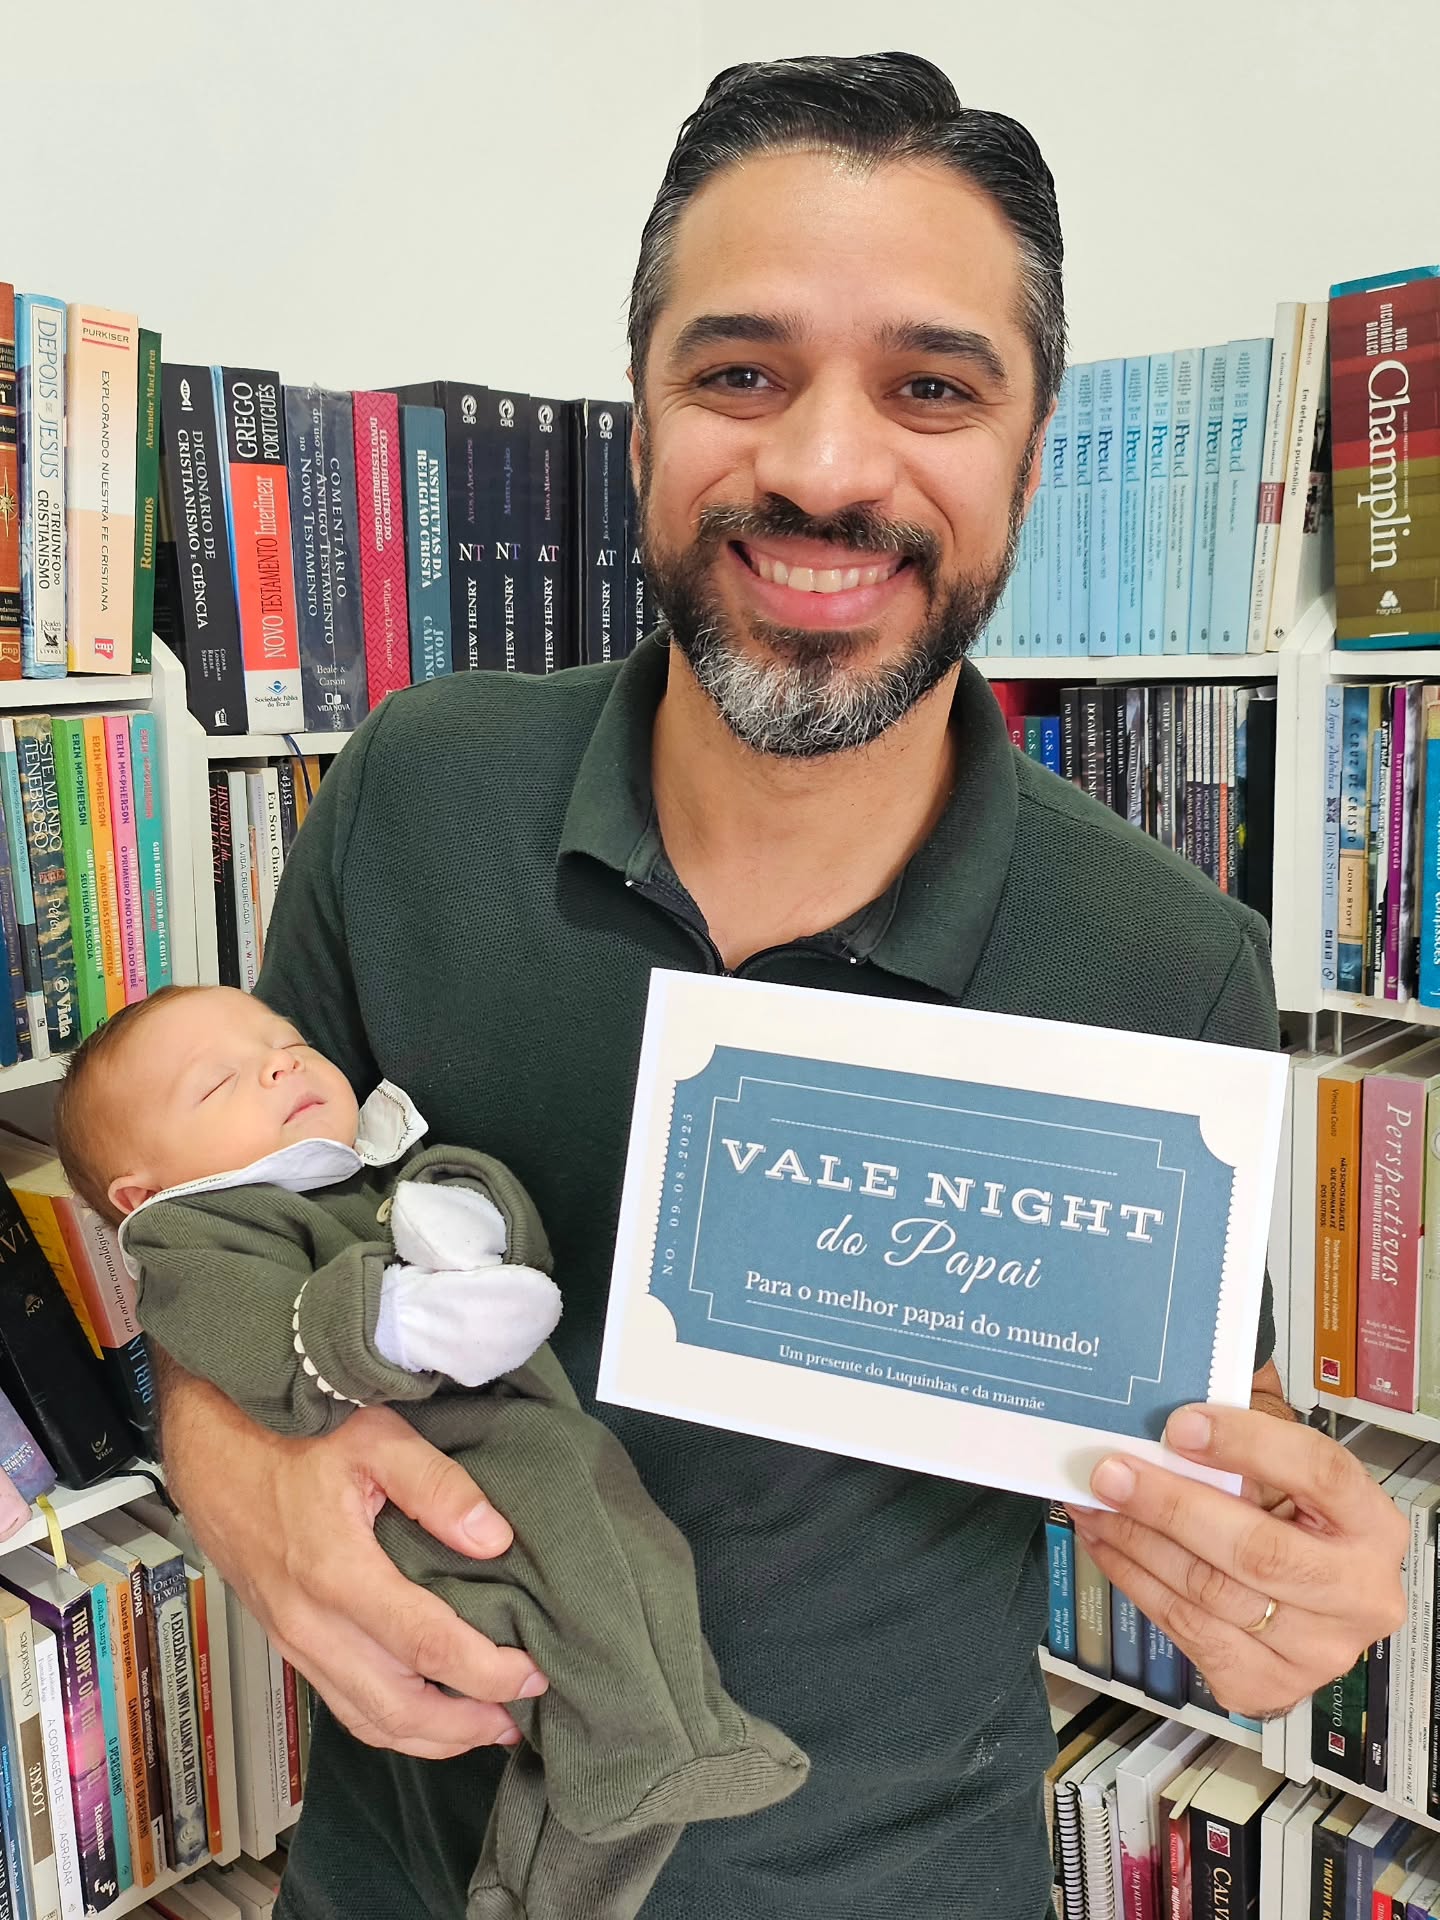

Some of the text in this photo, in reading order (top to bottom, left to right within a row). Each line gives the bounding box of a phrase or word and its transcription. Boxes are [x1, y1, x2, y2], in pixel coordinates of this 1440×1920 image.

[83, 327, 130, 344] PURKISER
[1366, 322, 1378, 356] BÍBLICO
[1380, 303, 1392, 353] DICIONÁRIO
[1395, 327, 1407, 351] NOVO
[37, 318, 60, 478] DEPOIS JESUS
[232, 382, 254, 459] GREGO
[255, 384, 280, 460] PORTUGUÊS
[145, 402, 155, 449] Alexander
[1151, 425, 1168, 479] Freud
[1174, 424, 1190, 478] Freud
[1205, 420, 1222, 476] Freud
[1230, 417, 1247, 473] Freud
[1053, 436, 1068, 488] Freud
[1076, 434, 1091, 486] Freud
[1098, 429, 1113, 483] Freud
[1126, 429, 1141, 483] Freud
[1357, 359, 1412, 573] Champlin
[100, 370, 109, 612] EXPLORANDO NUESTRA FE CRISTIANA
[193, 430, 216, 560] DICIONÁRIO DE
[316, 472, 327, 536] ANTIGO
[37, 490, 50, 589] CRISTIANISMO
[51, 510, 61, 570] TRIUNFO
[140, 497, 154, 569] Romanos
[177, 430, 209, 629] CRISTIANISMO CIÊNCIA
[301, 457, 318, 617] NOVO TESTAMENTO
[330, 457, 346, 598] COMENTÁRIO
[375, 518, 383, 551] GREGO
[429, 459, 442, 580] INSTITUTAS DA
[255, 476, 286, 659] NOVO TESTAMENTO Interlinear
[459, 542, 484, 562] NT
[496, 542, 521, 560] NT
[538, 545, 560, 562] AT
[596, 549, 617, 567] AT
[319, 537, 334, 644] TESTAMENTO
[383, 578, 394, 618] William
[468, 576, 477, 628] HENRY
[505, 575, 515, 624] HENRY
[544, 576, 553, 625] HENRY
[602, 580, 611, 629] HENRY
[636, 579, 644, 626] HENRY
[317, 665, 337, 674] Beale
[319, 677, 346, 686] Carson
[72, 733, 80, 759] ERIN
[92, 735, 100, 760] ERIN
[116, 733, 124, 761] ERIN
[1325, 712, 1337, 789] Igreja Autêntica
[24, 740, 41, 851] TENEBROSO
[43, 766, 63, 851] MUNDO
[1347, 732, 1359, 843] CRUZ DE CRISTO
[1392, 753, 1404, 869] hermenêutica avançada
[267, 791, 277, 840] Eu Sou
[1202, 832, 1210, 864] ORAÇÃO
[1227, 844, 1235, 877] ORAÇÃO
[1325, 830, 1336, 897] JOHN STOTT
[121, 855, 130, 897] PRIMEIRO
[1345, 896, 1354, 927] STOTT
[84, 929, 93, 959] ESCOLA
[58, 1000, 72, 1038] Vida
[670, 1111, 694, 1230] 09.08.2025
[720, 1138, 1163, 1242] VALE NIGHT
[1376, 1102, 1413, 1287] Perspectivas
[817, 1214, 1042, 1297] do Papai
[1371, 1222, 1379, 1249] CRISTÃO
[97, 1225, 134, 1334] em ordem cronológica
[745, 1271, 1100, 1356] Para o melhor papai do mundo!
[128, 1338, 153, 1407] BÍBLIA
[779, 1345, 1045, 1410] Um presente do Luquinhas e da mamãe
[132, 1573, 144, 1617] UNOPAR
[153, 1572, 185, 1591] ORTON
[72, 1607, 88, 1641] THE
[120, 1593, 132, 1679] Charles Spurgeon
[171, 1620, 184, 1674] EXCELÊNCIA
[19, 1632, 32, 1708] Os Pensadores
[74, 1638, 92, 1683] HOPE
[141, 1667, 149, 1695] Teorias
[162, 1622, 176, 1716] COMENTÁRIO EXAUSTIVO
[178, 1691, 188, 1718] NOVA
[1333, 1686, 1343, 1727] COUTO
[180, 1720, 192, 1757] ALIANÇA
[277, 1738, 286, 1770] PODEM
[29, 1762, 46, 1816] LOCKE
[110, 1749, 122, 1797] PEREGRINO
[128, 1697, 140, 1750] CAMINHANDO
[135, 1788, 148, 1838] PEREGRINO
[186, 1773, 197, 1805] CRISTO
[280, 1773, 288, 1801] TODOS
[48, 1729, 61, 1784] CORAGEM
[58, 1833, 73, 1886] AGRADAR
[94, 1803, 106, 1862] Reasoner
[1212, 1867, 1232, 1920] CALV
[1323, 1857, 1333, 1906] TIMOTHY
